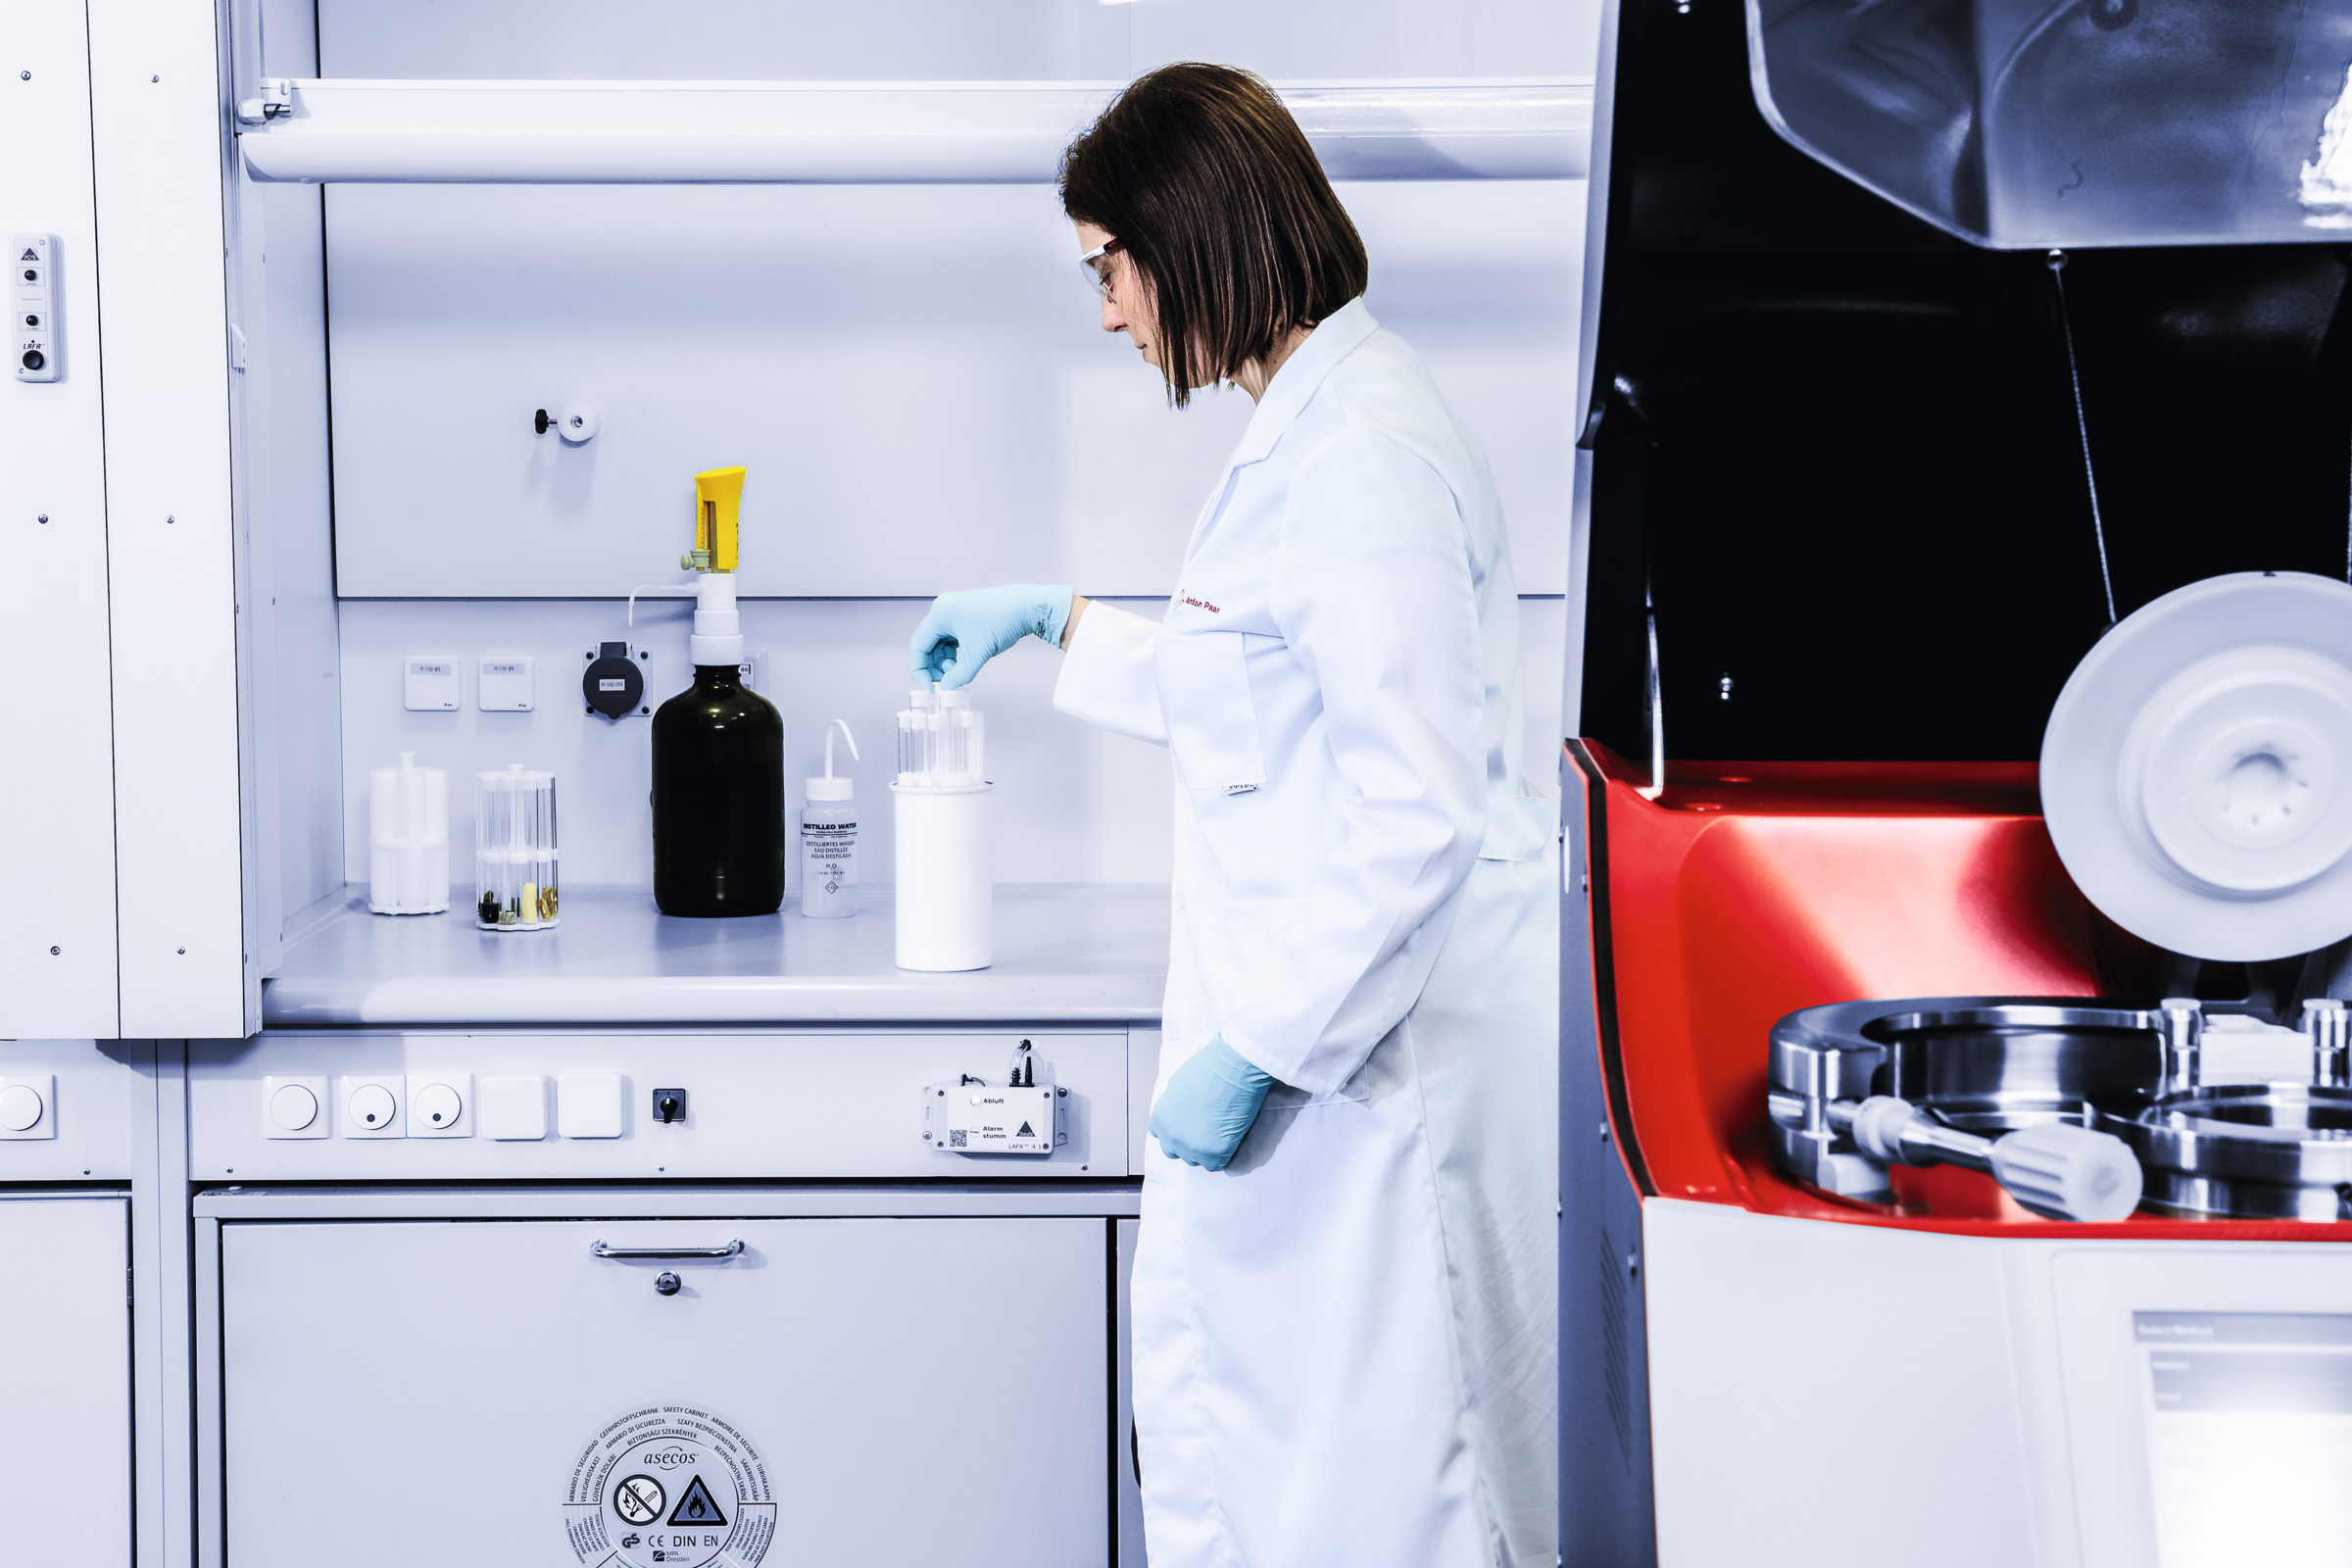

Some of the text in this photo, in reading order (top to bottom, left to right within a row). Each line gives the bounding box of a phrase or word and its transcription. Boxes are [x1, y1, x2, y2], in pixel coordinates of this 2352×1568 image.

[1185, 596, 1220, 613] Anton Paar
[684, 1408, 709, 1418] CABINET
[600, 1408, 659, 1439] GEFAHRSTOFFSCHRANK
[711, 1417, 734, 1434] ARMOIRE
[606, 1431, 627, 1449] ARMARIO
[635, 1419, 665, 1430] SICUREZZA
[627, 1429, 697, 1446] BIZTONSÁGI SZEKRÉNYEK
[601, 1454, 616, 1473] DOLABI
[644, 1452, 696, 1464] asecos
[569, 1477, 578, 1502] ARMARIO
[578, 1440, 598, 1468] SEGURIDAD
[581, 1456, 600, 1502] VEILIGHEIDSKAST
[757, 1464, 770, 1500] TURVAKAAPPI
[622, 1534, 641, 1548] GS
[649, 1536, 663, 1547] CE
[673, 1536, 696, 1547] DIN
[705, 1536, 718, 1546] EN
